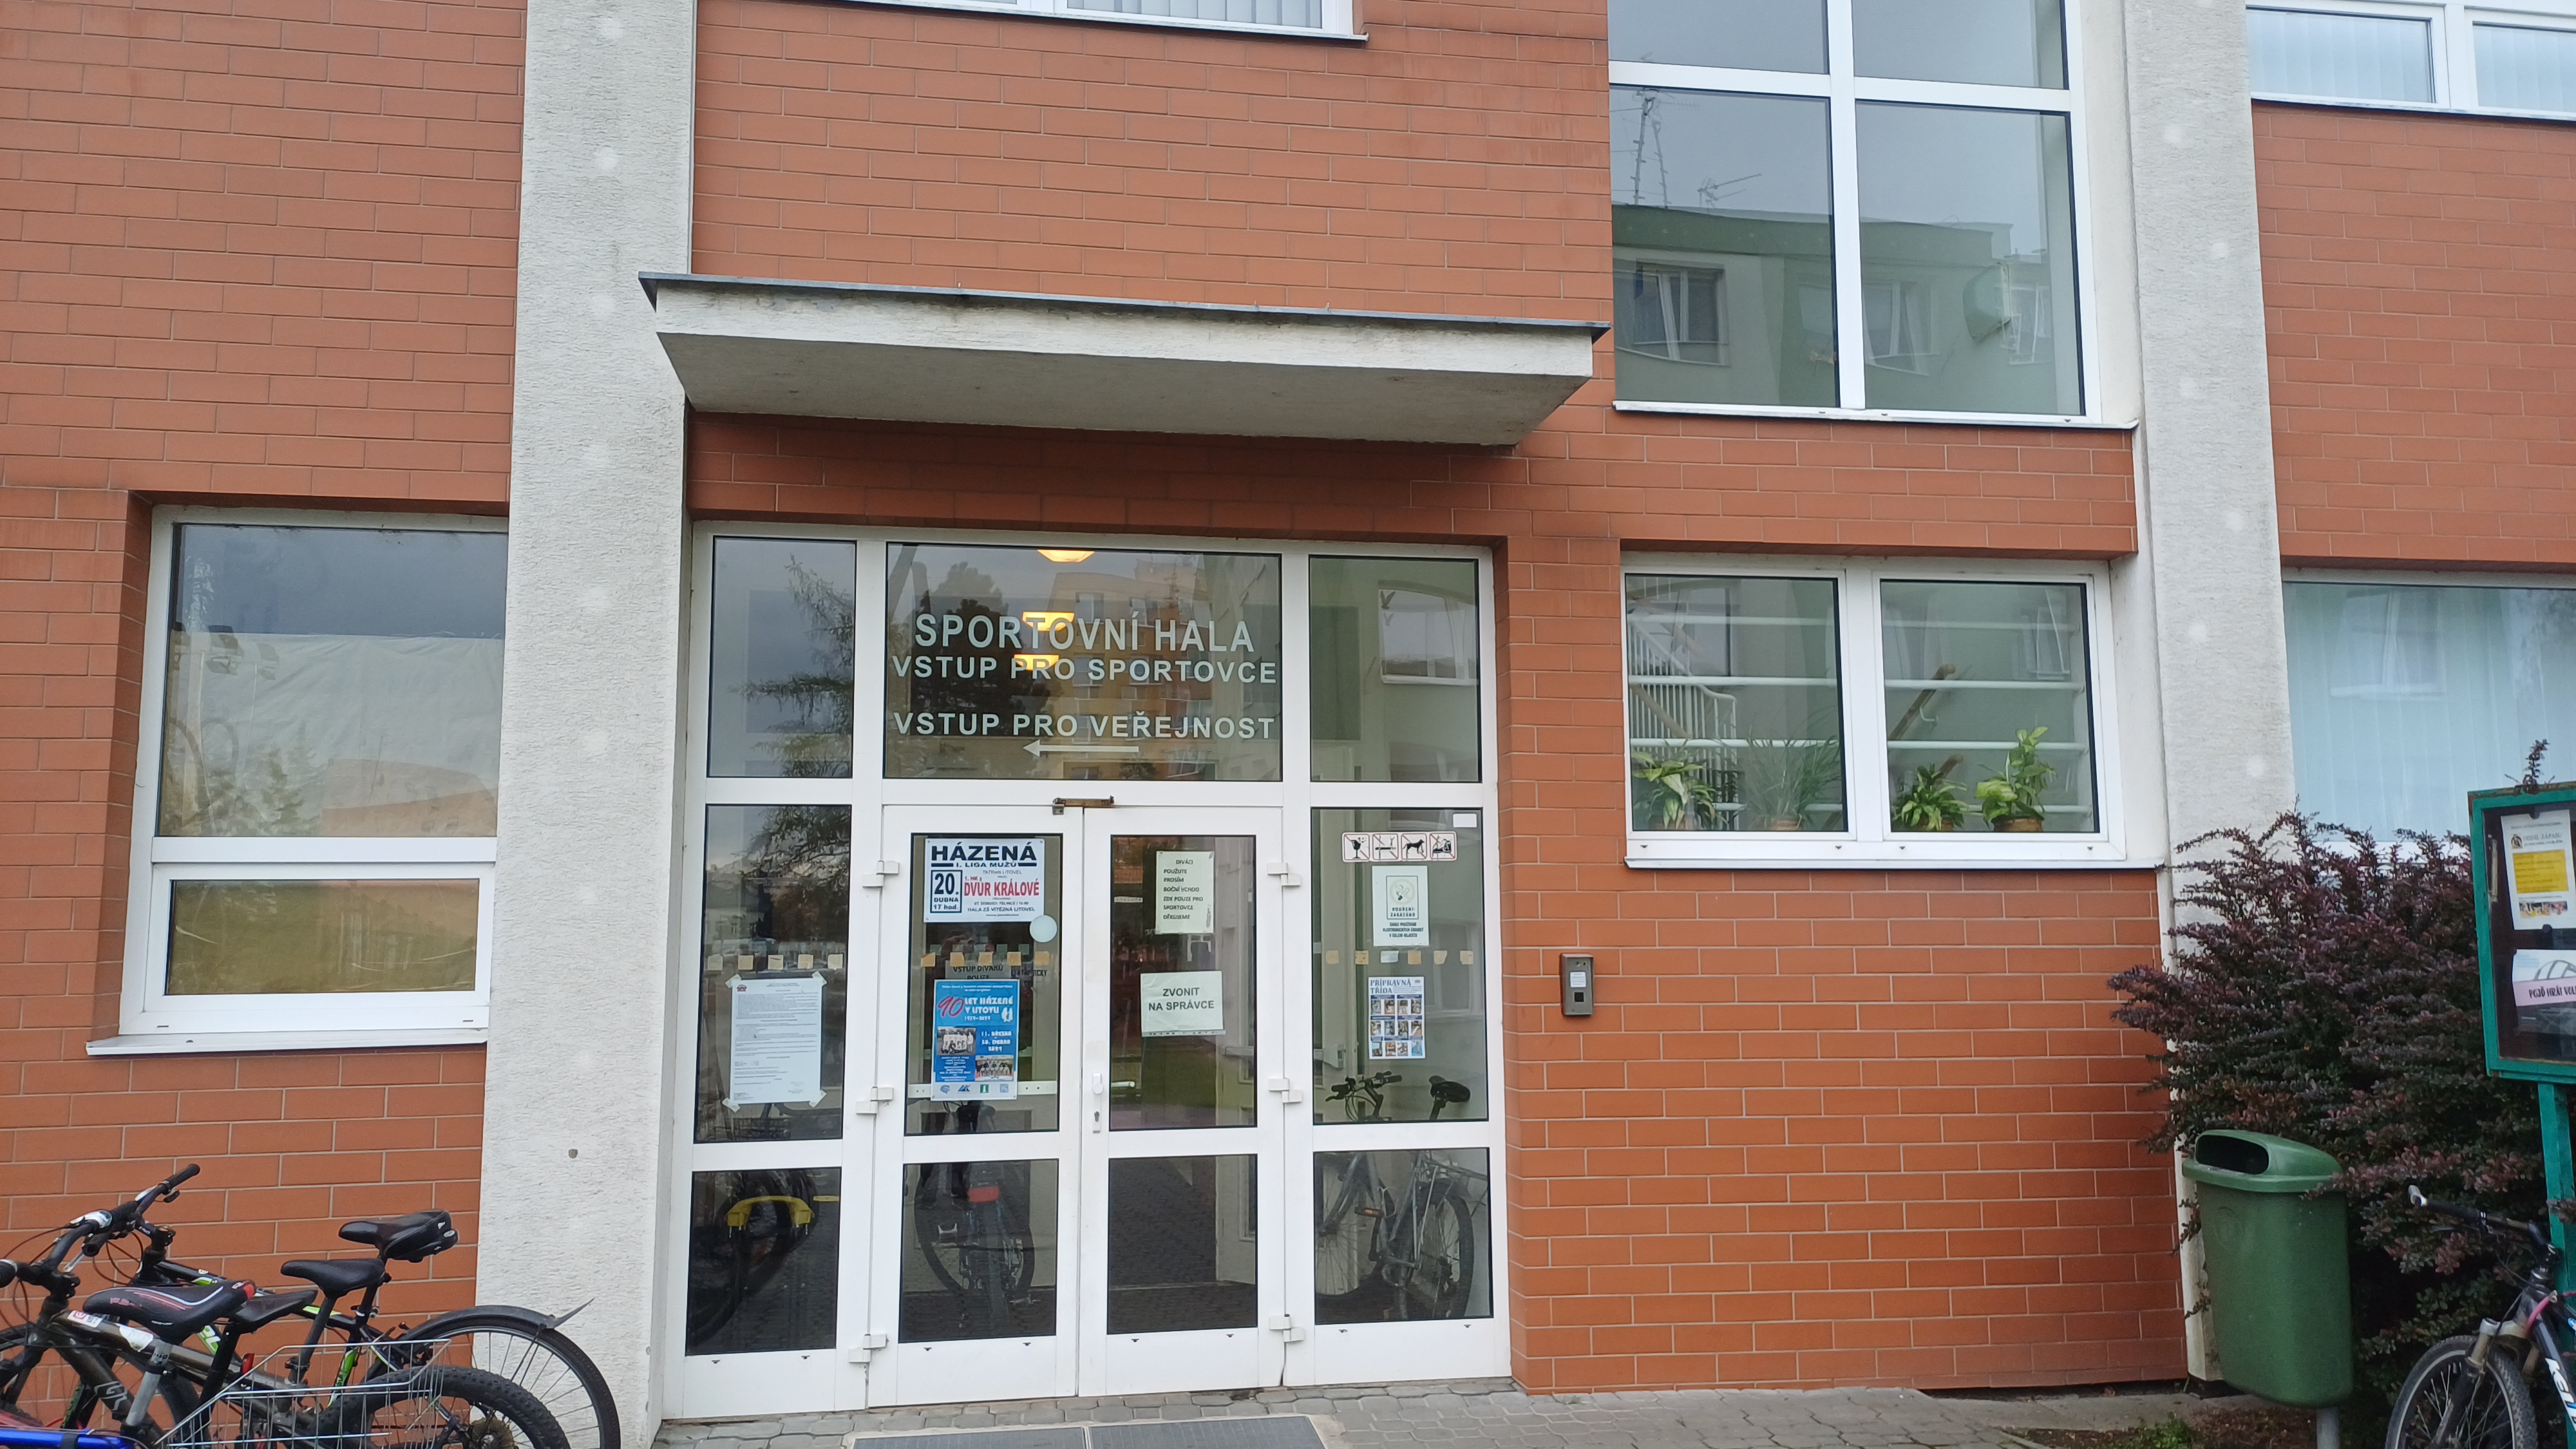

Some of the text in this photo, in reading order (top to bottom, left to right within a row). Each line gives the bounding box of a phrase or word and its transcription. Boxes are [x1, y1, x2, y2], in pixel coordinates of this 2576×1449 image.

[914, 611, 1255, 652] SPORTOVNÍ HALA
[893, 656, 1276, 683] VSTUP PRO SPORTOVCE
[893, 711, 1275, 739] VSTUP PRO VEŘEJNOST
[931, 841, 1037, 861] HÁZENÁ
[934, 873, 959, 895] 20.
[964, 876, 1039, 896] DVŮR KRÁLOVÉ
[1162, 987, 1200, 996] ZVONIT
[1370, 978, 1412, 987] PŘÍPRAVNÁ
[1148, 999, 1215, 1011] NA SPRÁVCE
